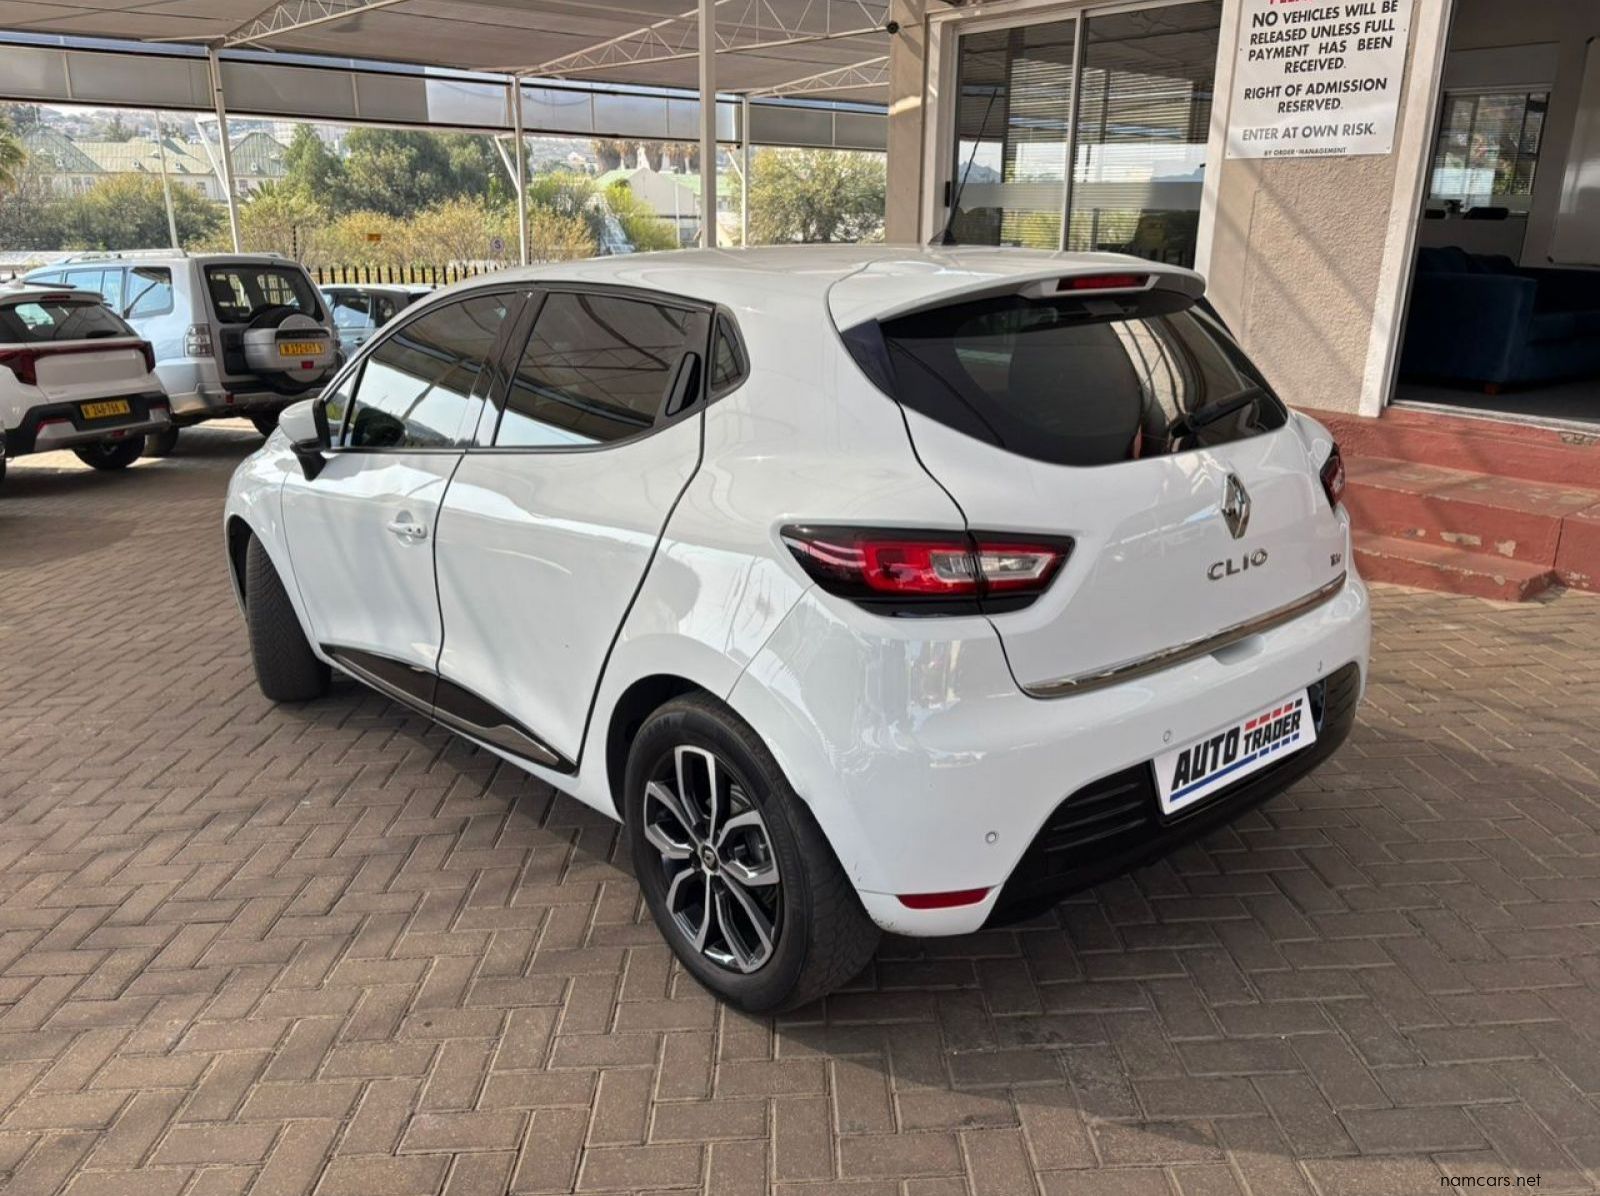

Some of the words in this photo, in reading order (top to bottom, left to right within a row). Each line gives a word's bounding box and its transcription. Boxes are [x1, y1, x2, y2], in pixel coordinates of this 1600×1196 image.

[1252, 11, 1278, 28] NO
[1283, 7, 1340, 24] VEHICLES
[1344, 2, 1377, 17] WILL
[1381, 0, 1399, 13] BE
[1250, 28, 1307, 45] RELEASED
[1311, 23, 1361, 39] UNLESS
[1364, 19, 1396, 33] FULL
[1248, 44, 1309, 61] PAYMENT
[1318, 40, 1347, 55] HAS
[1357, 36, 1393, 51] BEEN
[1284, 57, 1347, 74] RECEIVED.
[1244, 85, 1281, 100] RIGHT
[1284, 84, 1302, 98] OF
[1305, 78, 1388, 95] ADMISSION
[1277, 98, 1344, 114] RESERVED.
[1242, 127, 1279, 141] ENTER
[1281, 126, 1298, 139] AT
[1302, 124, 1339, 138] OWN
[1342, 122, 1377, 137] RISK.
[1207, 548, 1268, 581] CLIO
[1170, 725, 1241, 792] AUTO
[1243, 709, 1302, 756] TRADER
